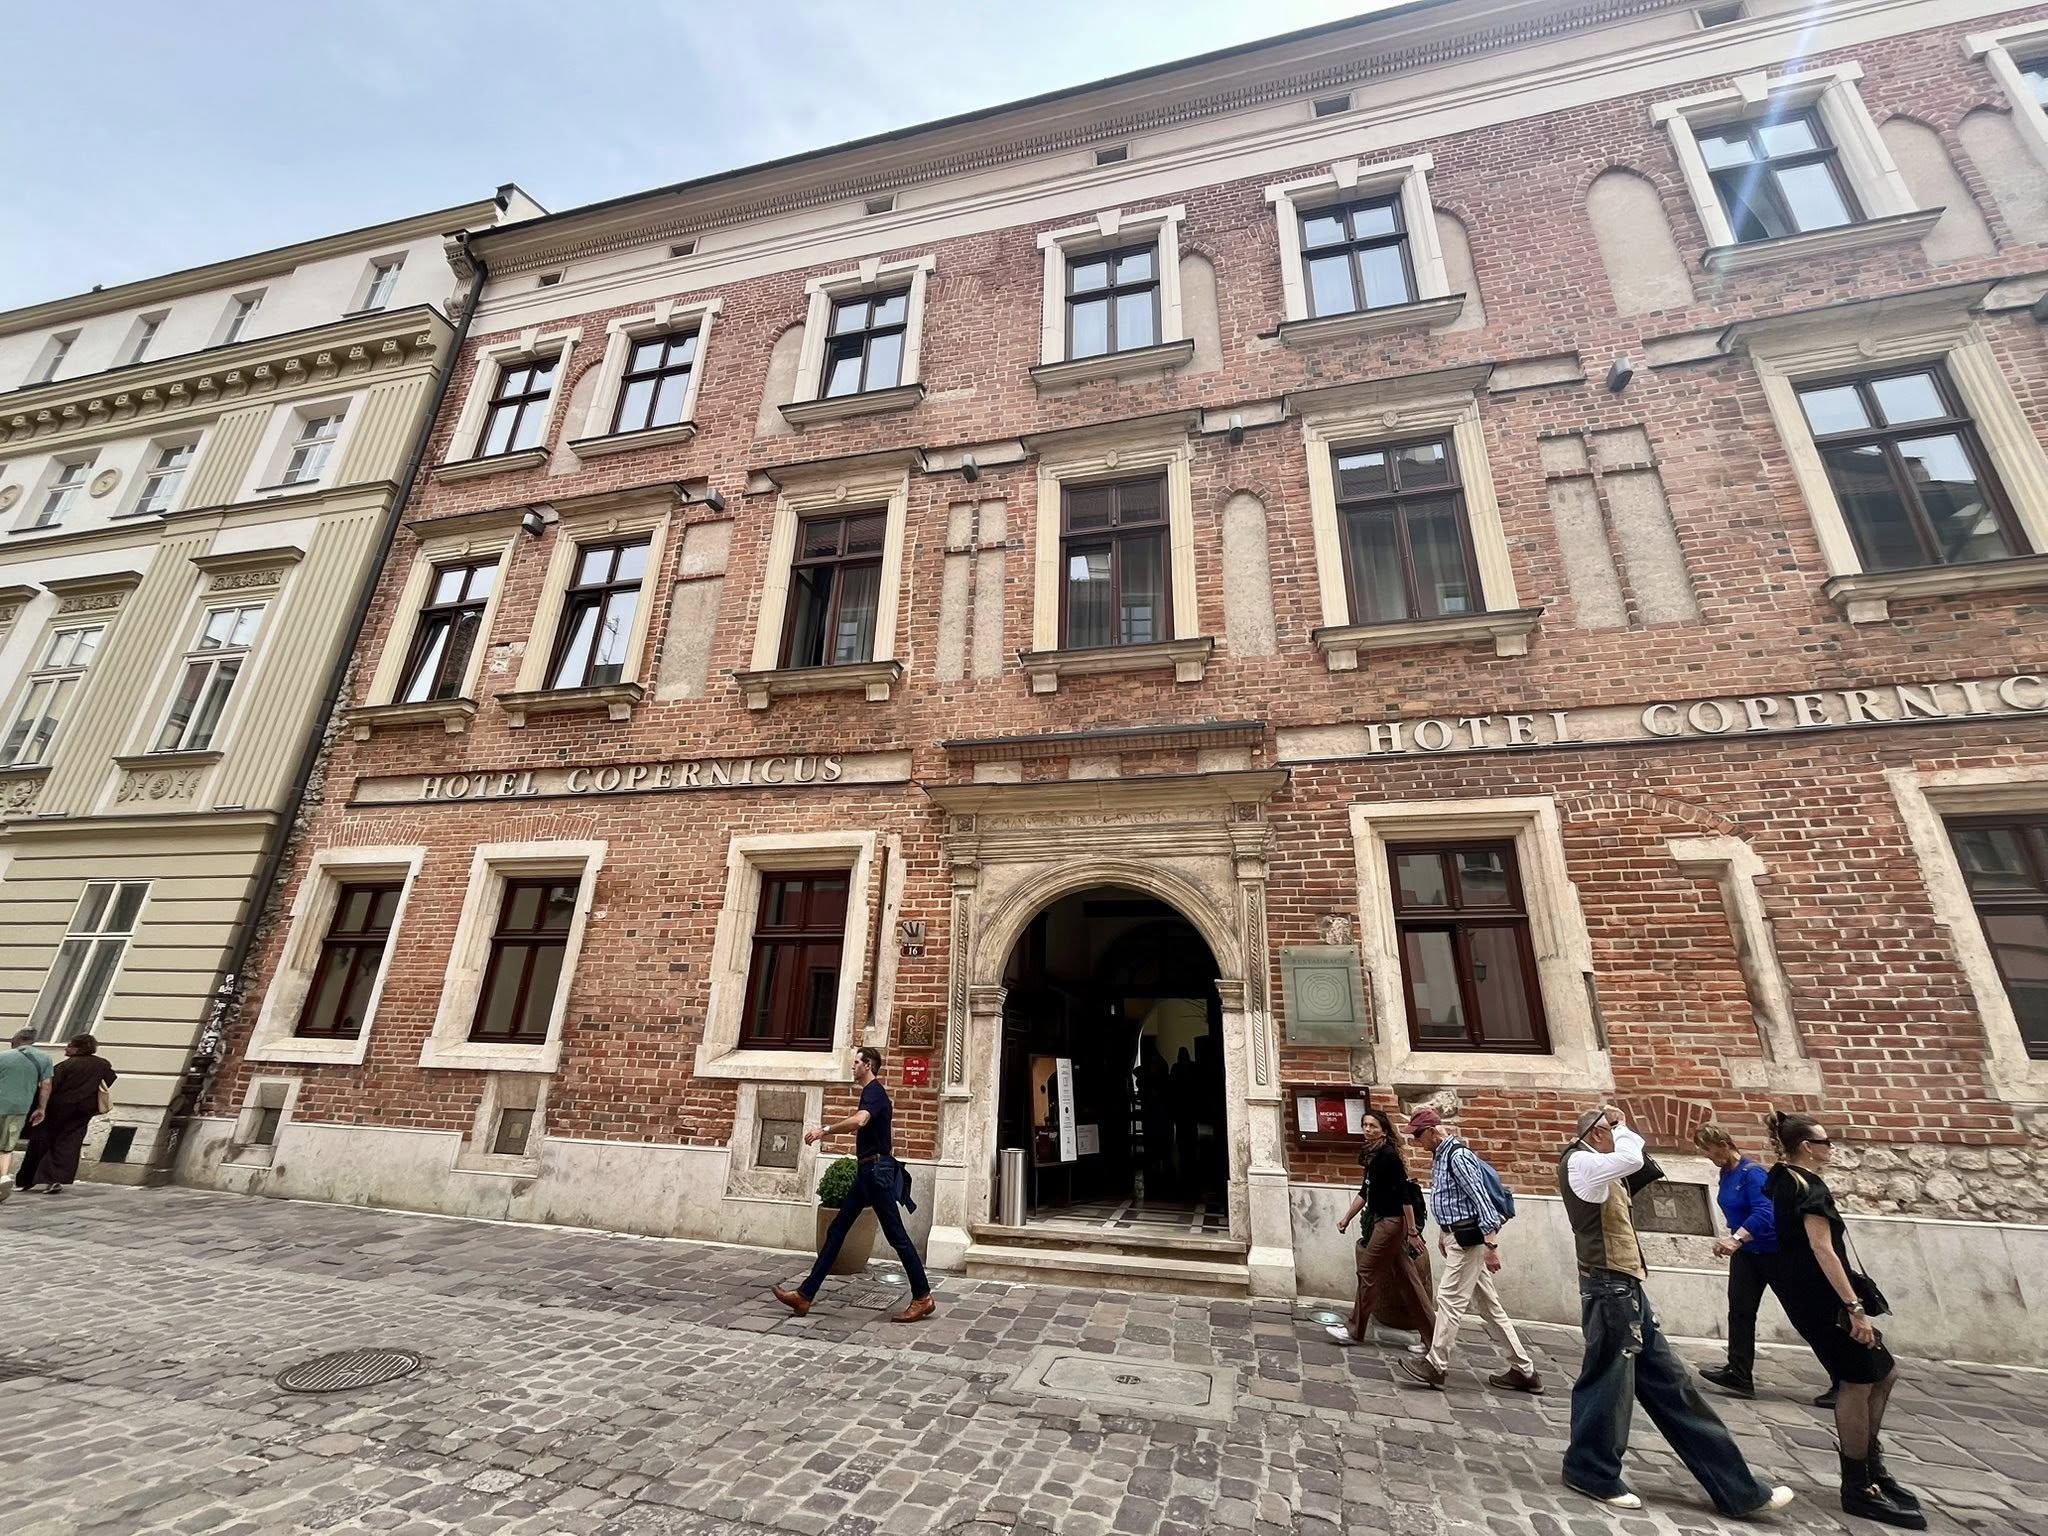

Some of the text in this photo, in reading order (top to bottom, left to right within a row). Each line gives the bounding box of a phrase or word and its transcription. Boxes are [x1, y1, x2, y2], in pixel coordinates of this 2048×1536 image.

[1364, 711, 1583, 754] HOTEL
[418, 754, 843, 799] HOTEL COPERNICUS
[909, 947, 918, 955] 16
